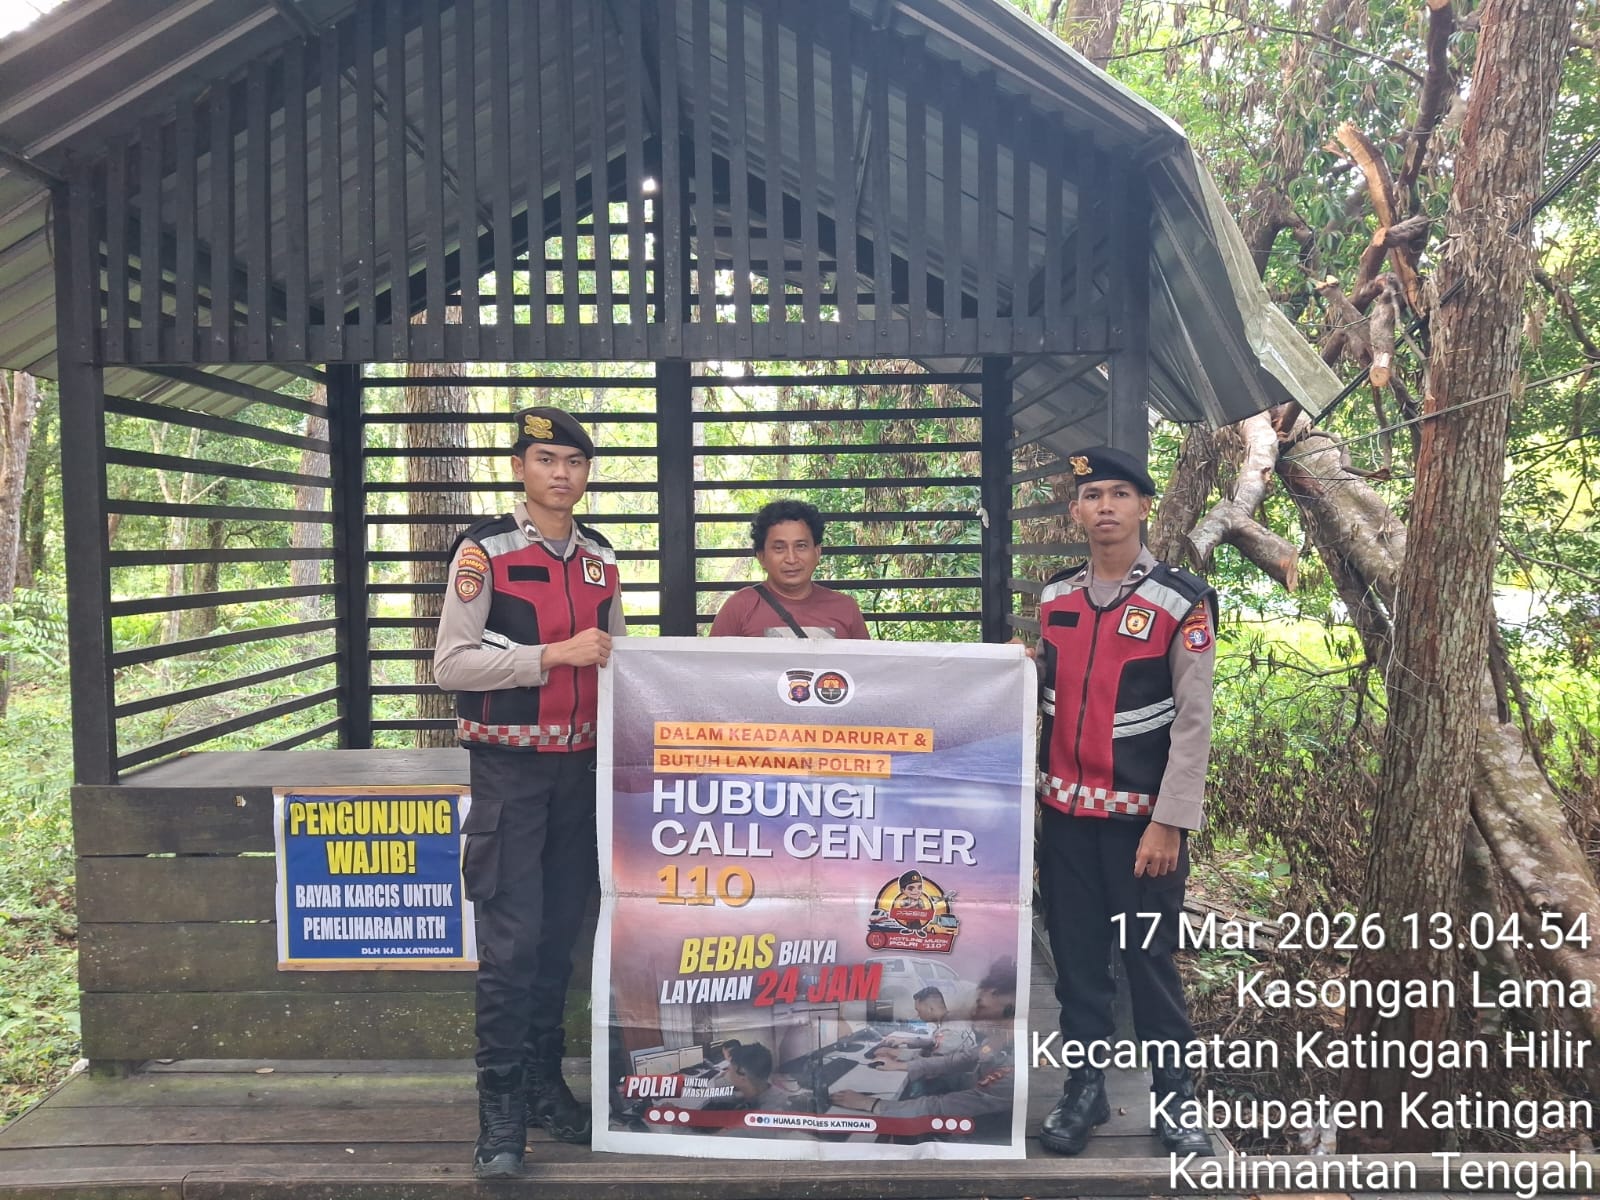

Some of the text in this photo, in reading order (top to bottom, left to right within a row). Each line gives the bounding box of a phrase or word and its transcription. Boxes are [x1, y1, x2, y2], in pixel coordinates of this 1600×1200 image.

[660, 726, 927, 747] DALAM KEADAAN DARURAT &
[660, 754, 886, 773] BUTUH LAYANAN POLRI ?
[652, 779, 876, 819] HUBUNGI
[289, 799, 452, 836] PENGUNJUNG
[651, 819, 977, 866] CALL CENTER
[326, 840, 417, 875] WAJIB!
[295, 883, 453, 908] BAYAR KARCIS UNTUK
[656, 864, 755, 908] 110
[303, 916, 446, 941] PEMELIHARAAN RTH
[361, 947, 381, 955] DLH
[679, 933, 837, 974] BEBAS BIAYA
[660, 962, 884, 1007] LAYANAN 24 JAM
[626, 1076, 678, 1098] POLRI
[682, 1086, 735, 1098] MASYARAKAT
[773, 1117, 801, 1125] HUMAS
